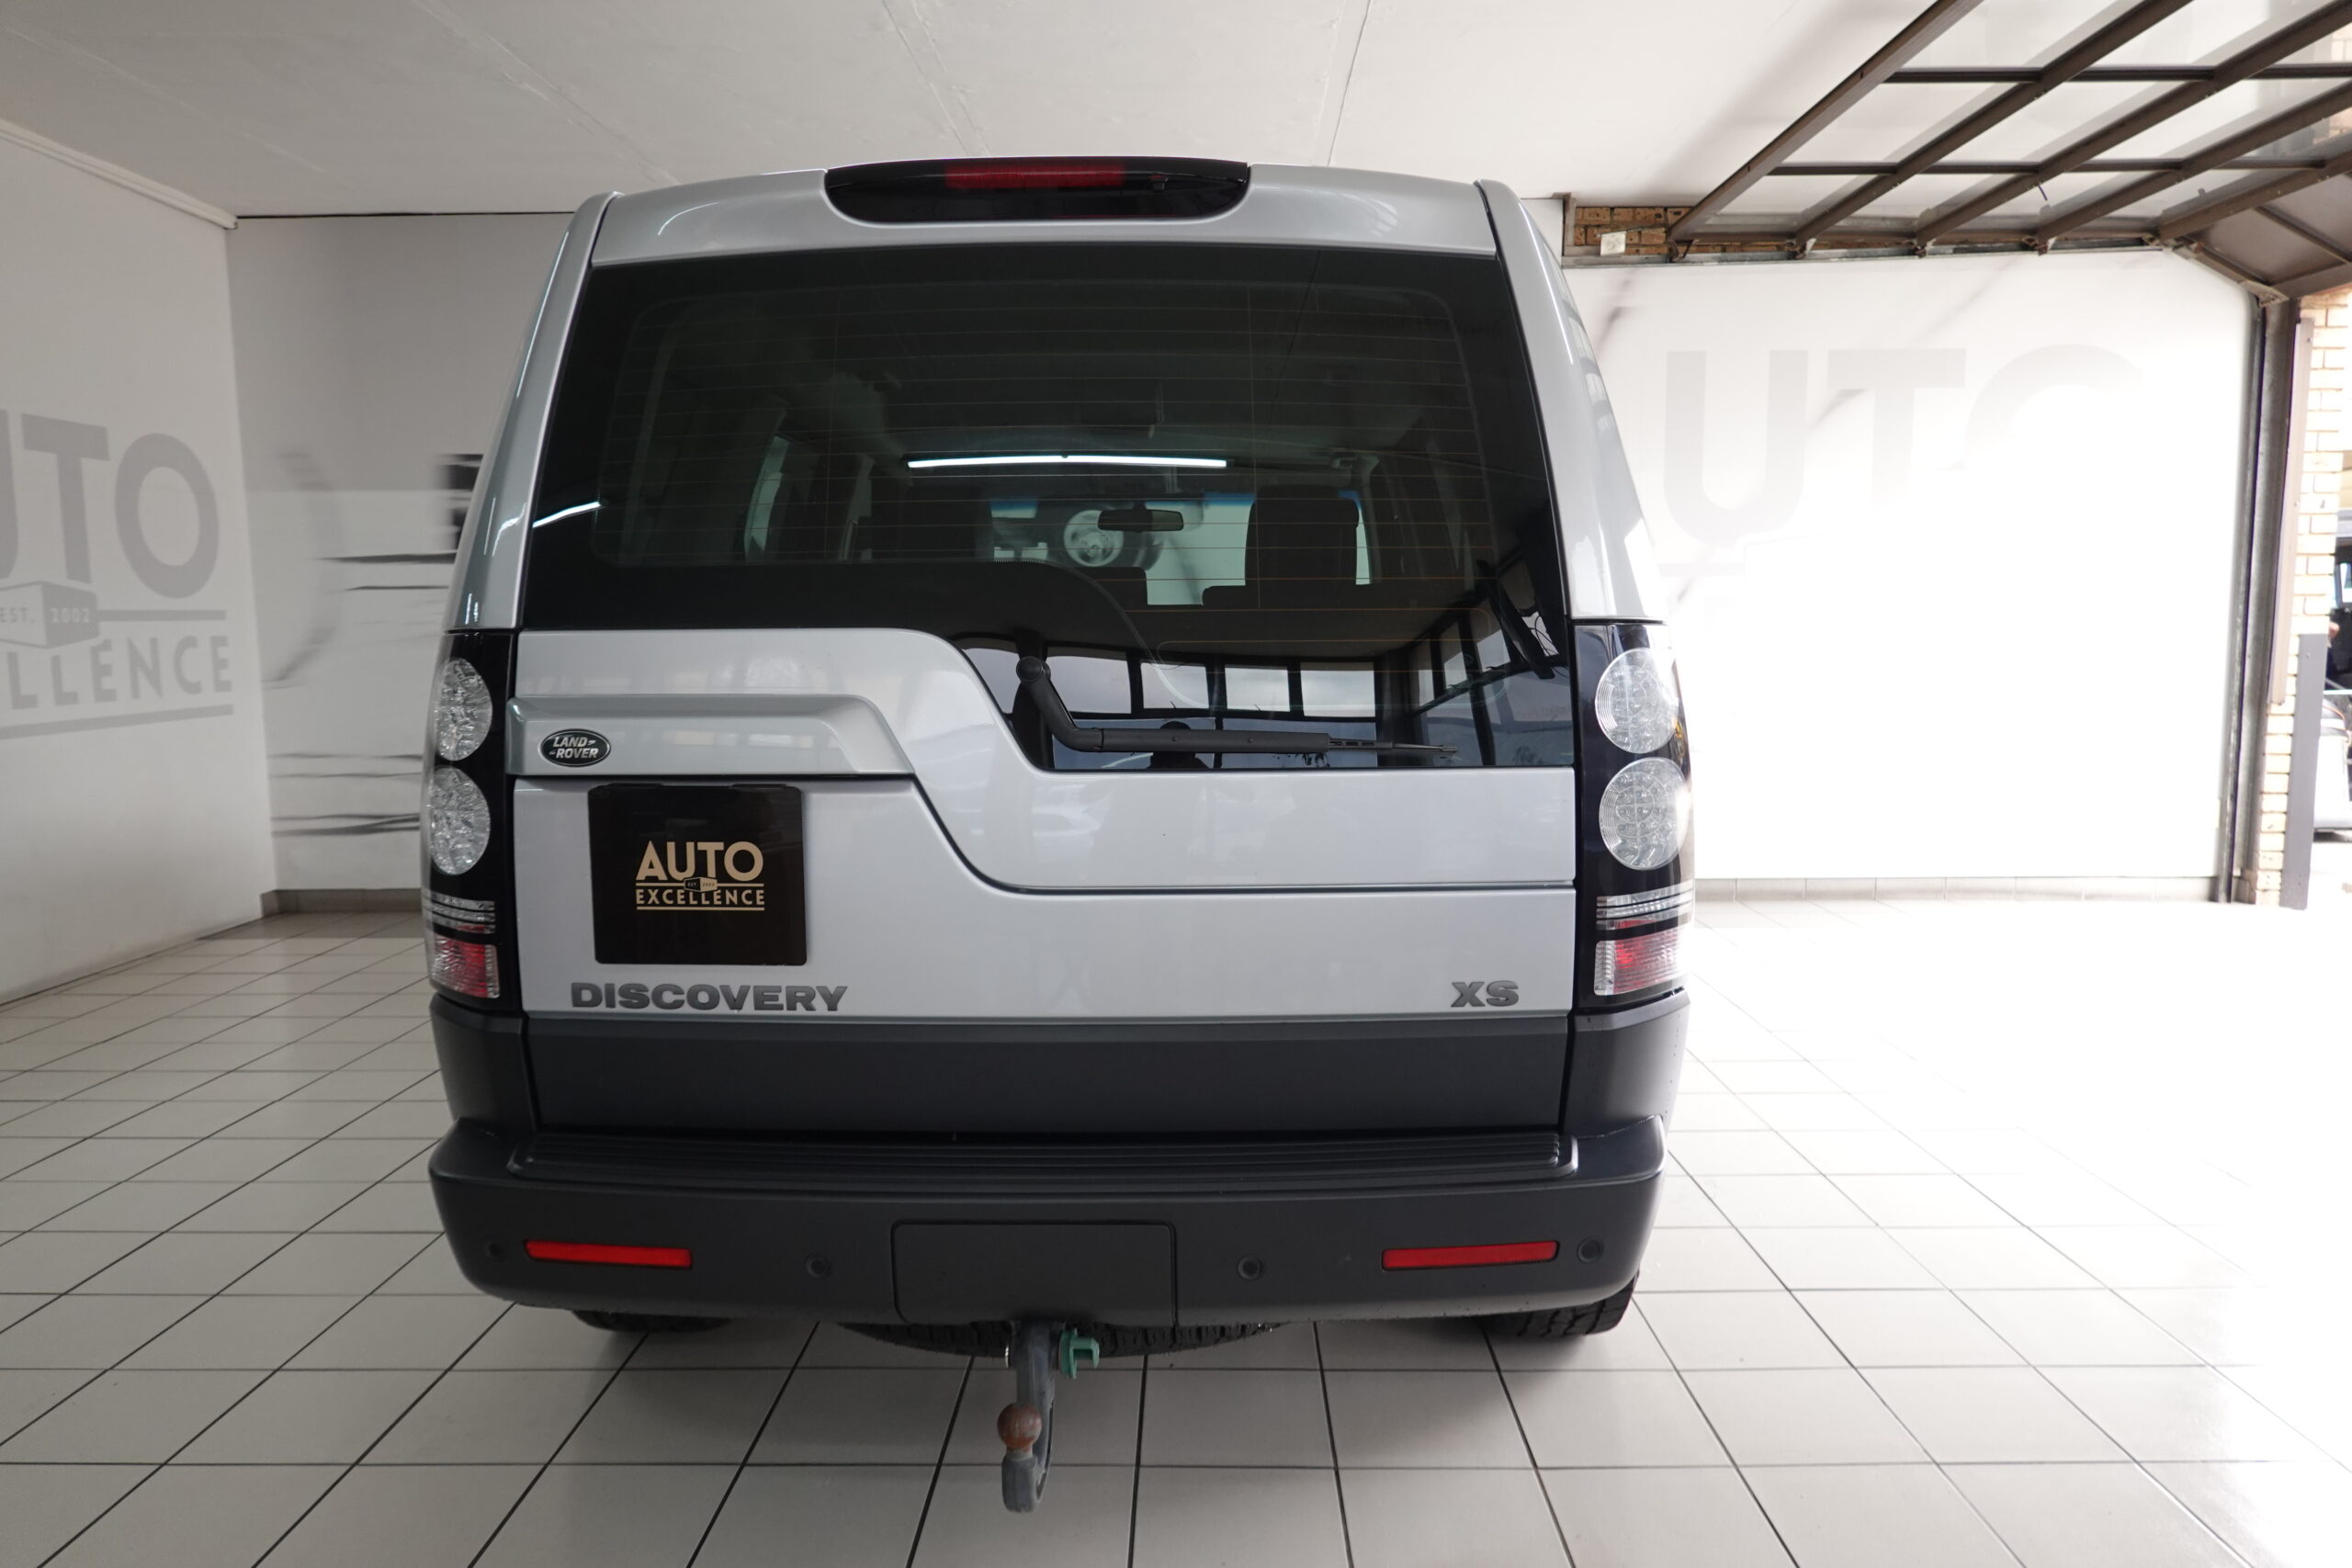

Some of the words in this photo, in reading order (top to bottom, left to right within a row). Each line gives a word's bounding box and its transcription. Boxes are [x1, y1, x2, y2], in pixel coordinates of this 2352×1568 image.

[553, 736, 588, 747] LAND
[556, 748, 599, 759] ROVER
[636, 840, 763, 881] AUTO
[636, 888, 765, 906] EXCELLENCE
[571, 982, 848, 1011] DISCOVERY
[1450, 980, 1520, 1008] XS
